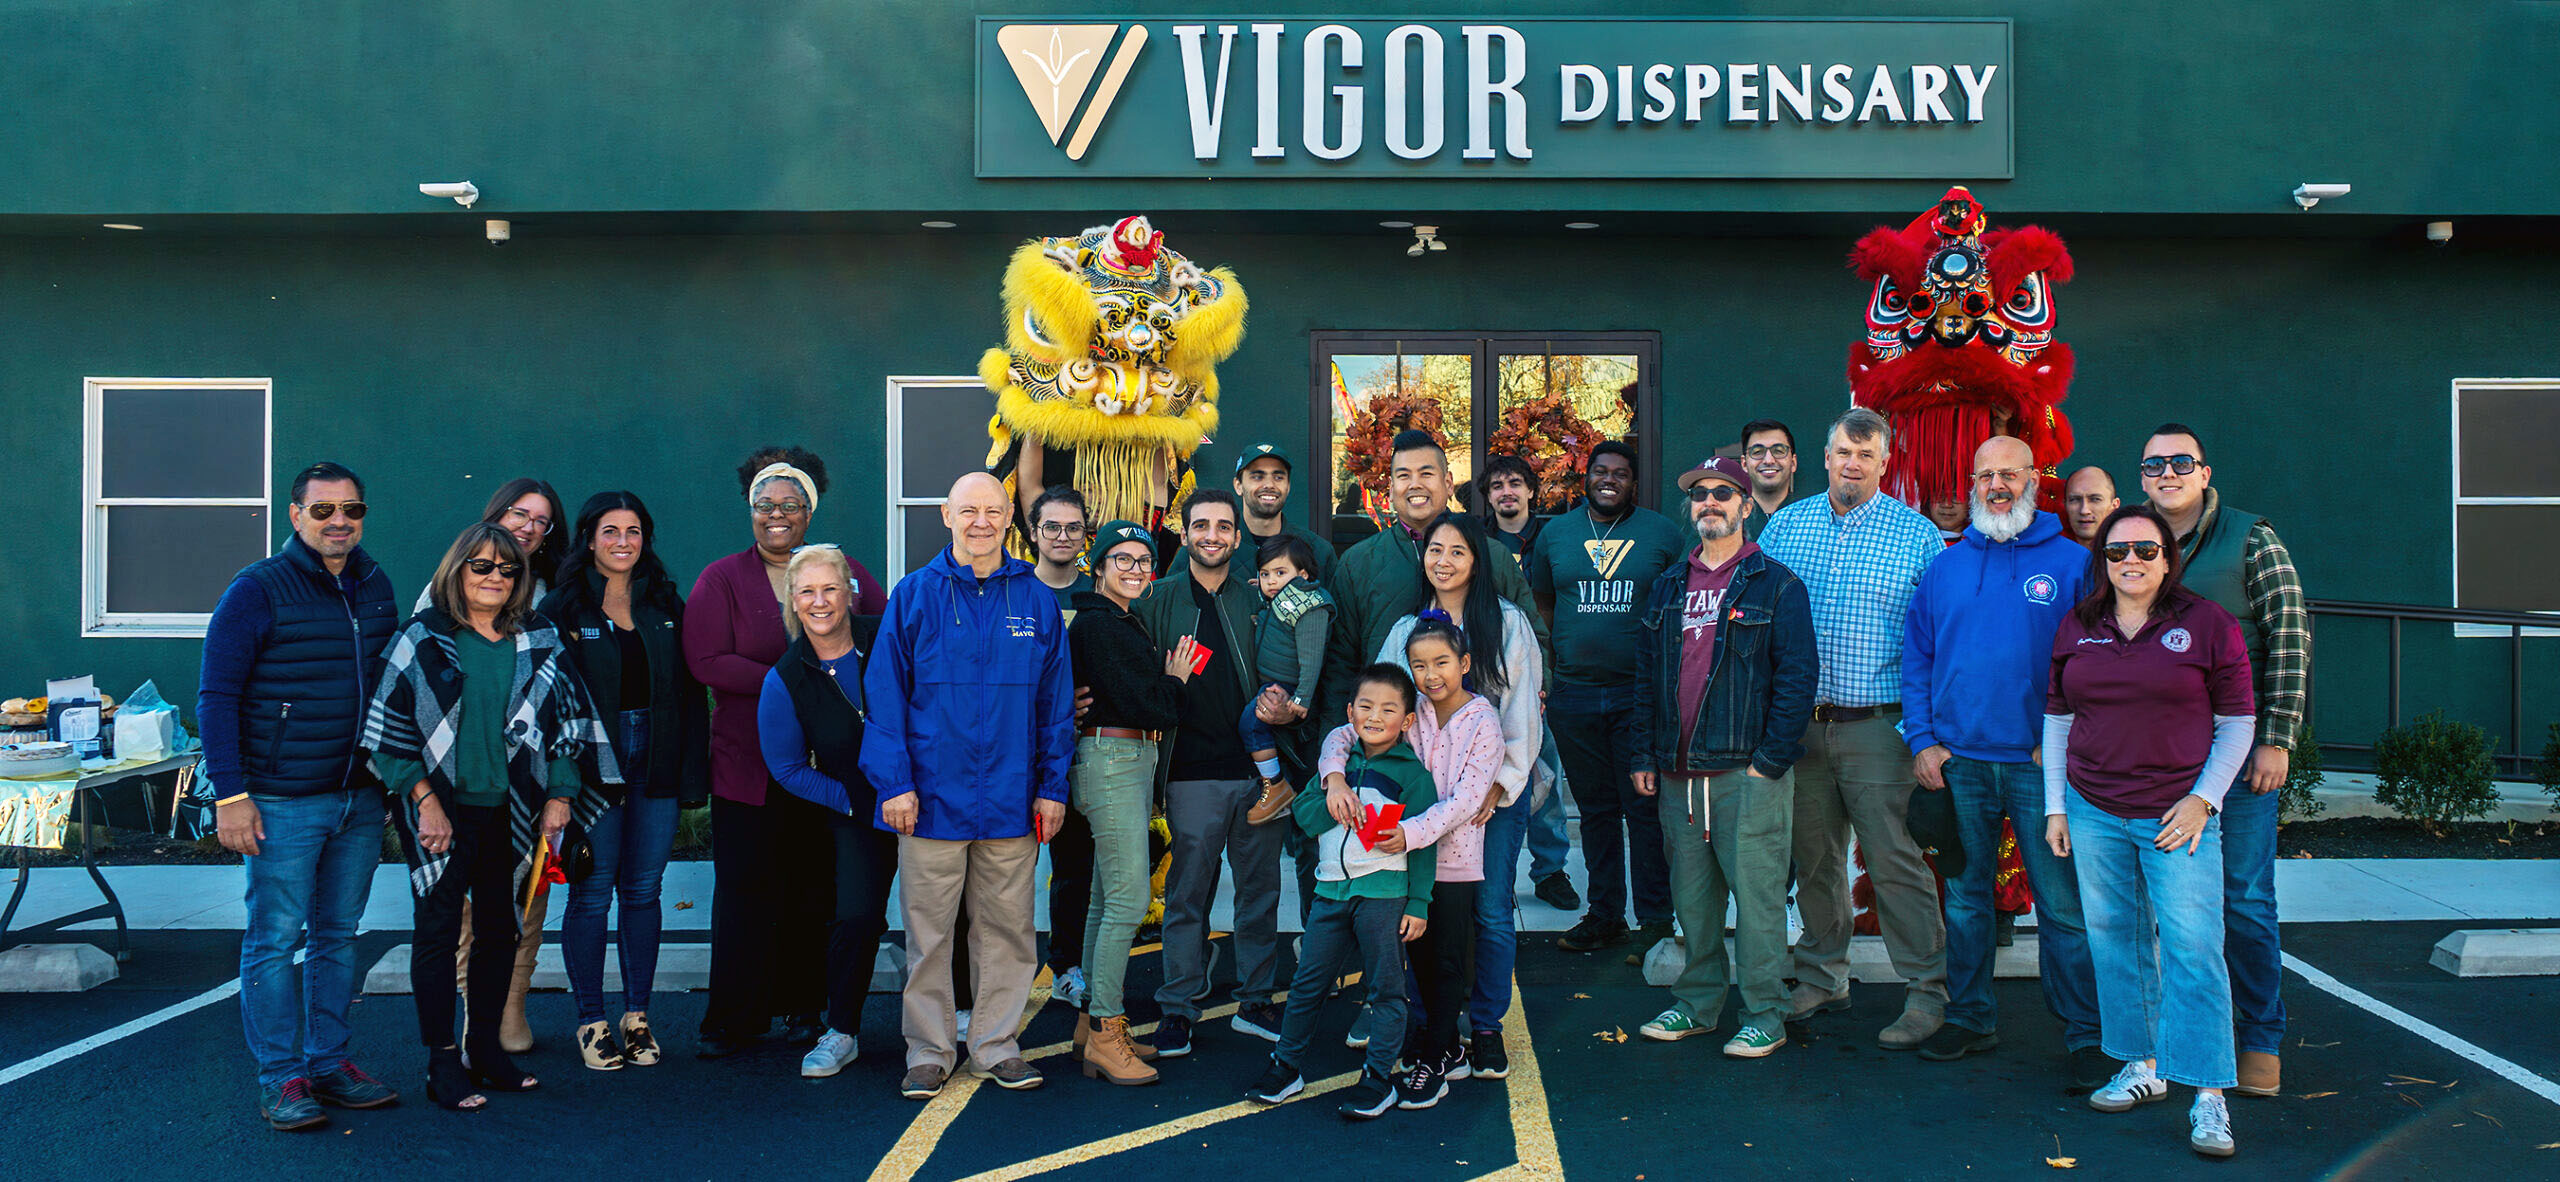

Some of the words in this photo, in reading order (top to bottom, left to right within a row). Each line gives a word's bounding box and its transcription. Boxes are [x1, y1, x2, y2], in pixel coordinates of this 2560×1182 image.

[1172, 23, 1533, 161] VIGOR
[1560, 63, 1999, 122] DISPENSARY
[1577, 580, 1634, 603] VIGOR
[1577, 604, 1633, 613] DISPENSARY
